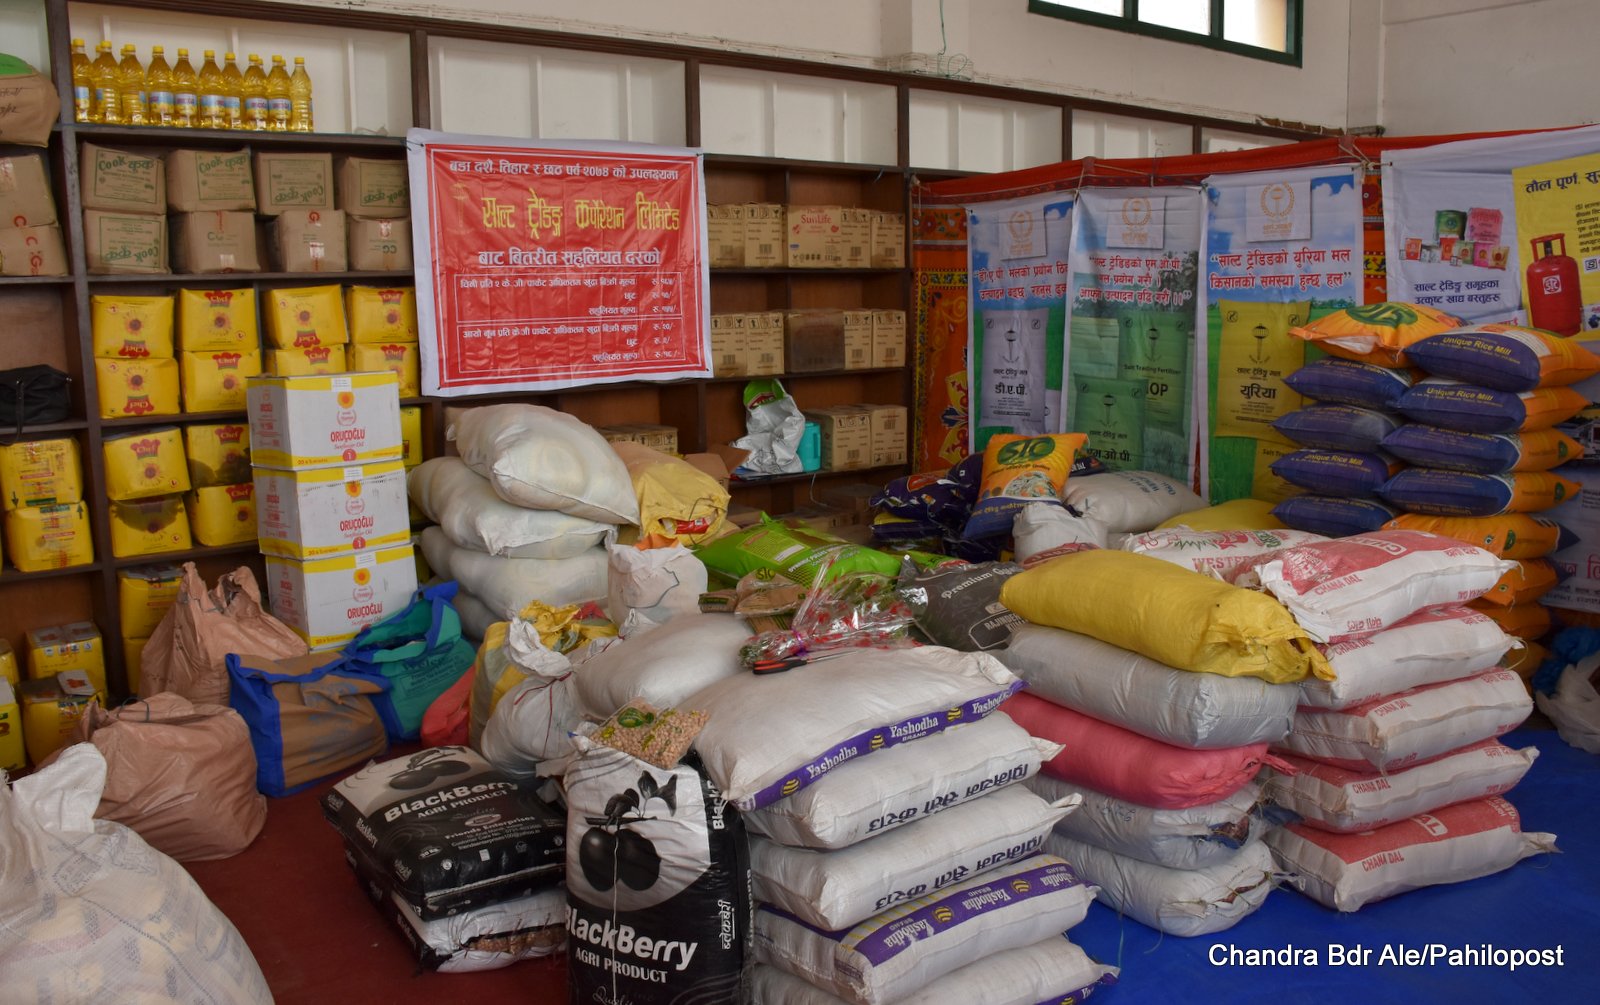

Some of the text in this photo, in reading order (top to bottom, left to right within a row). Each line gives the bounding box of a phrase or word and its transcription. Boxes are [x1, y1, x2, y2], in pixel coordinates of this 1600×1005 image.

[98, 155, 126, 171] Cook
[199, 155, 223, 174] Cook
[499, 159, 530, 174] तिहार
[533, 164, 541, 175] र
[613, 165, 626, 178] को
[1525, 179, 1551, 194] तौल
[481, 197, 516, 229] साल्ट
[635, 191, 680, 230] लिमिटेड
[478, 251, 505, 266] बाट
[625, 247, 661, 264] दरको
[1293, 246, 1326, 268] युरिया
[1331, 249, 1351, 262] मल
[1210, 272, 1255, 288] किसानको
[1260, 275, 1295, 287] समस्या
[1299, 273, 1321, 290] हुन्छ
[1414, 283, 1436, 292] साल्ट
[1465, 280, 1499, 291] समूहका
[1443, 337, 1472, 346] Unique
[1473, 340, 1494, 350] Rice
[1494, 345, 1512, 355] Mill
[1240, 384, 1276, 399] युरिया
[1426, 387, 1455, 396] Unique
[1456, 390, 1475, 398] Rice
[1476, 393, 1493, 401] Mill
[330, 427, 365, 443] ORUÇOĞLU
[1331, 454, 1348, 462] Rice
[1349, 456, 1363, 465] Mill
[339, 516, 374, 532] ORUÇOĞLU
[941, 572, 993, 599] Premium
[1314, 574, 1362, 596] CHANA DAL
[347, 602, 383, 619] ORUÇOĞLU
[1359, 638, 1374, 648] DAL
[1374, 699, 1411, 717] CHANA DAL
[889, 716, 938, 738] Yashodha
[902, 731, 927, 741] BRAND
[806, 746, 858, 779] Yashodha
[1352, 779, 1391, 793] CHANA DAL
[384, 782, 518, 822] BlackBerry
[417, 790, 508, 819] AGRI PRODUCT
[1362, 850, 1405, 872] CHANA DAL
[933, 866, 969, 888] सेतो
[962, 888, 1012, 911] Yashodha
[575, 947, 669, 984] AGRI PRODUCT
